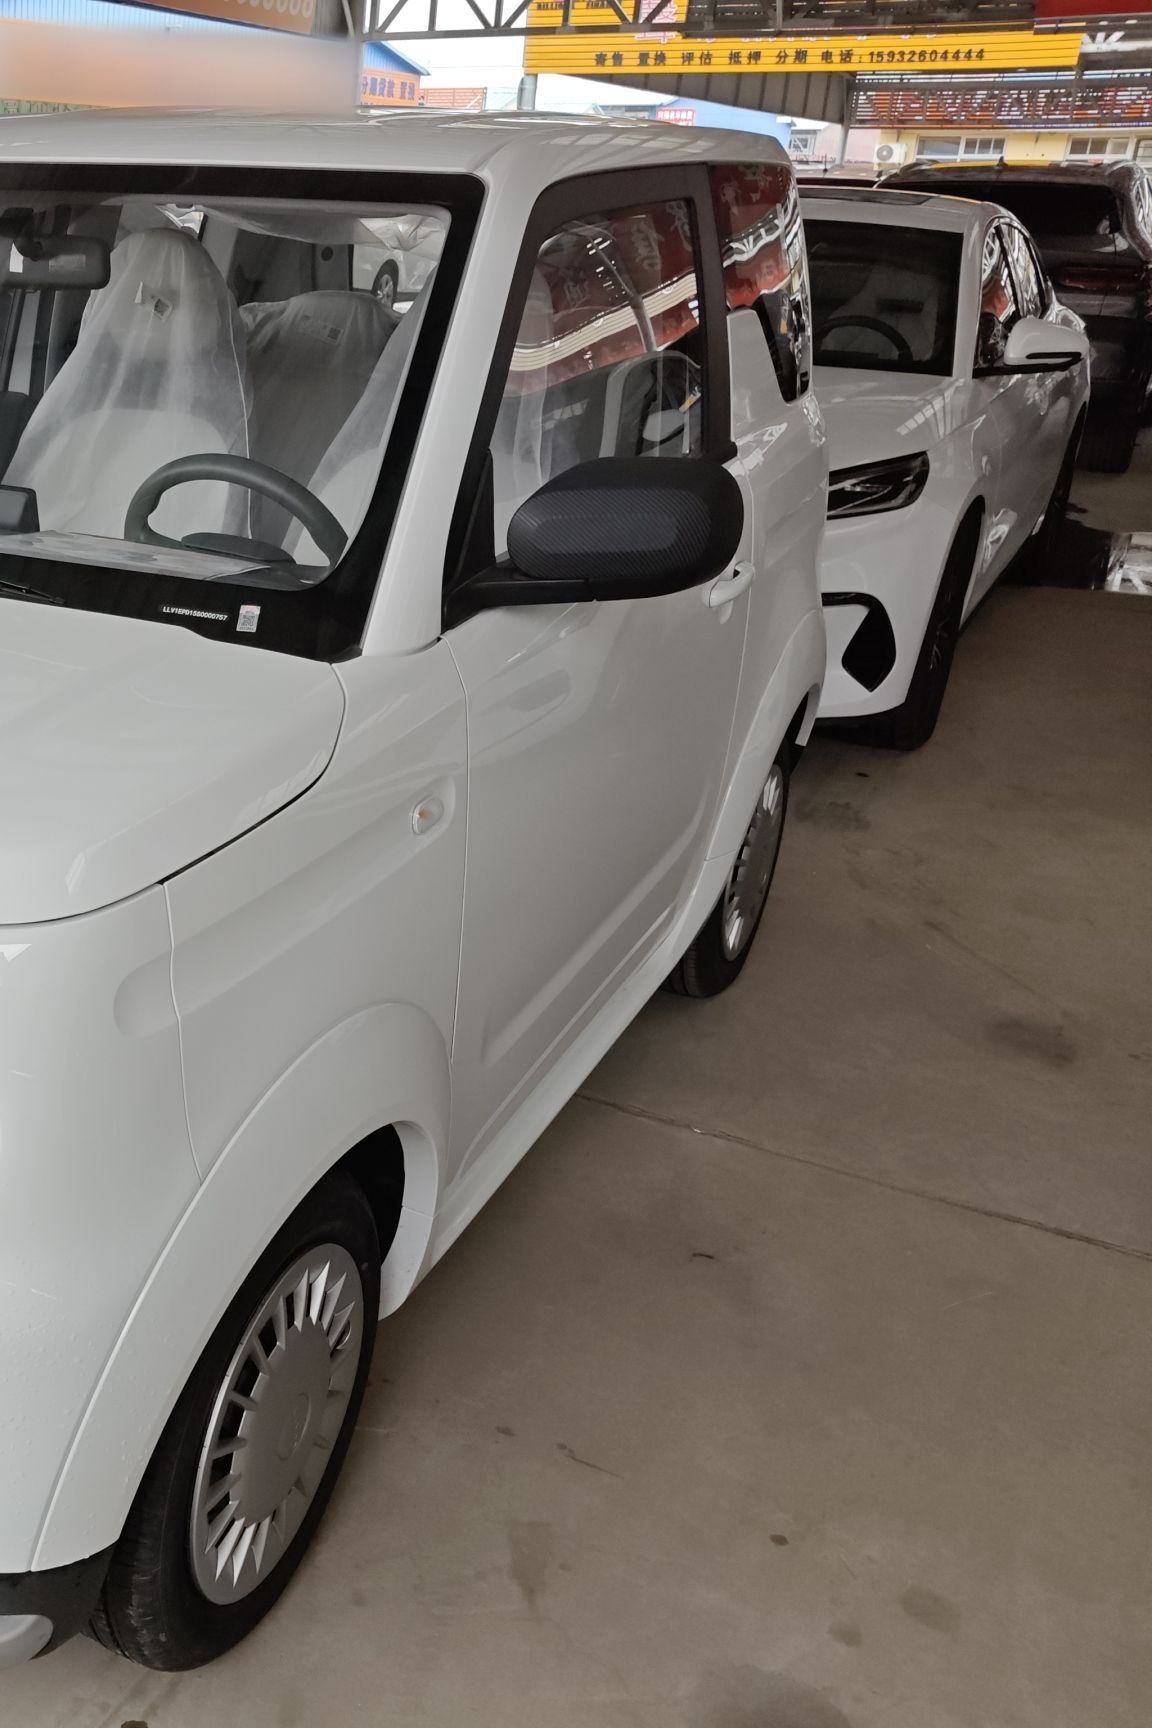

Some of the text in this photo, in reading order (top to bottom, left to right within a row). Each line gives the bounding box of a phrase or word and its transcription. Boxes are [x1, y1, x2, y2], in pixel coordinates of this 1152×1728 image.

[637, 50, 667, 67] 置换
[681, 51, 713, 65] 评估
[728, 50, 762, 65] 抵押
[775, 48, 808, 65] 分期
[868, 48, 986, 64] 15932604444
